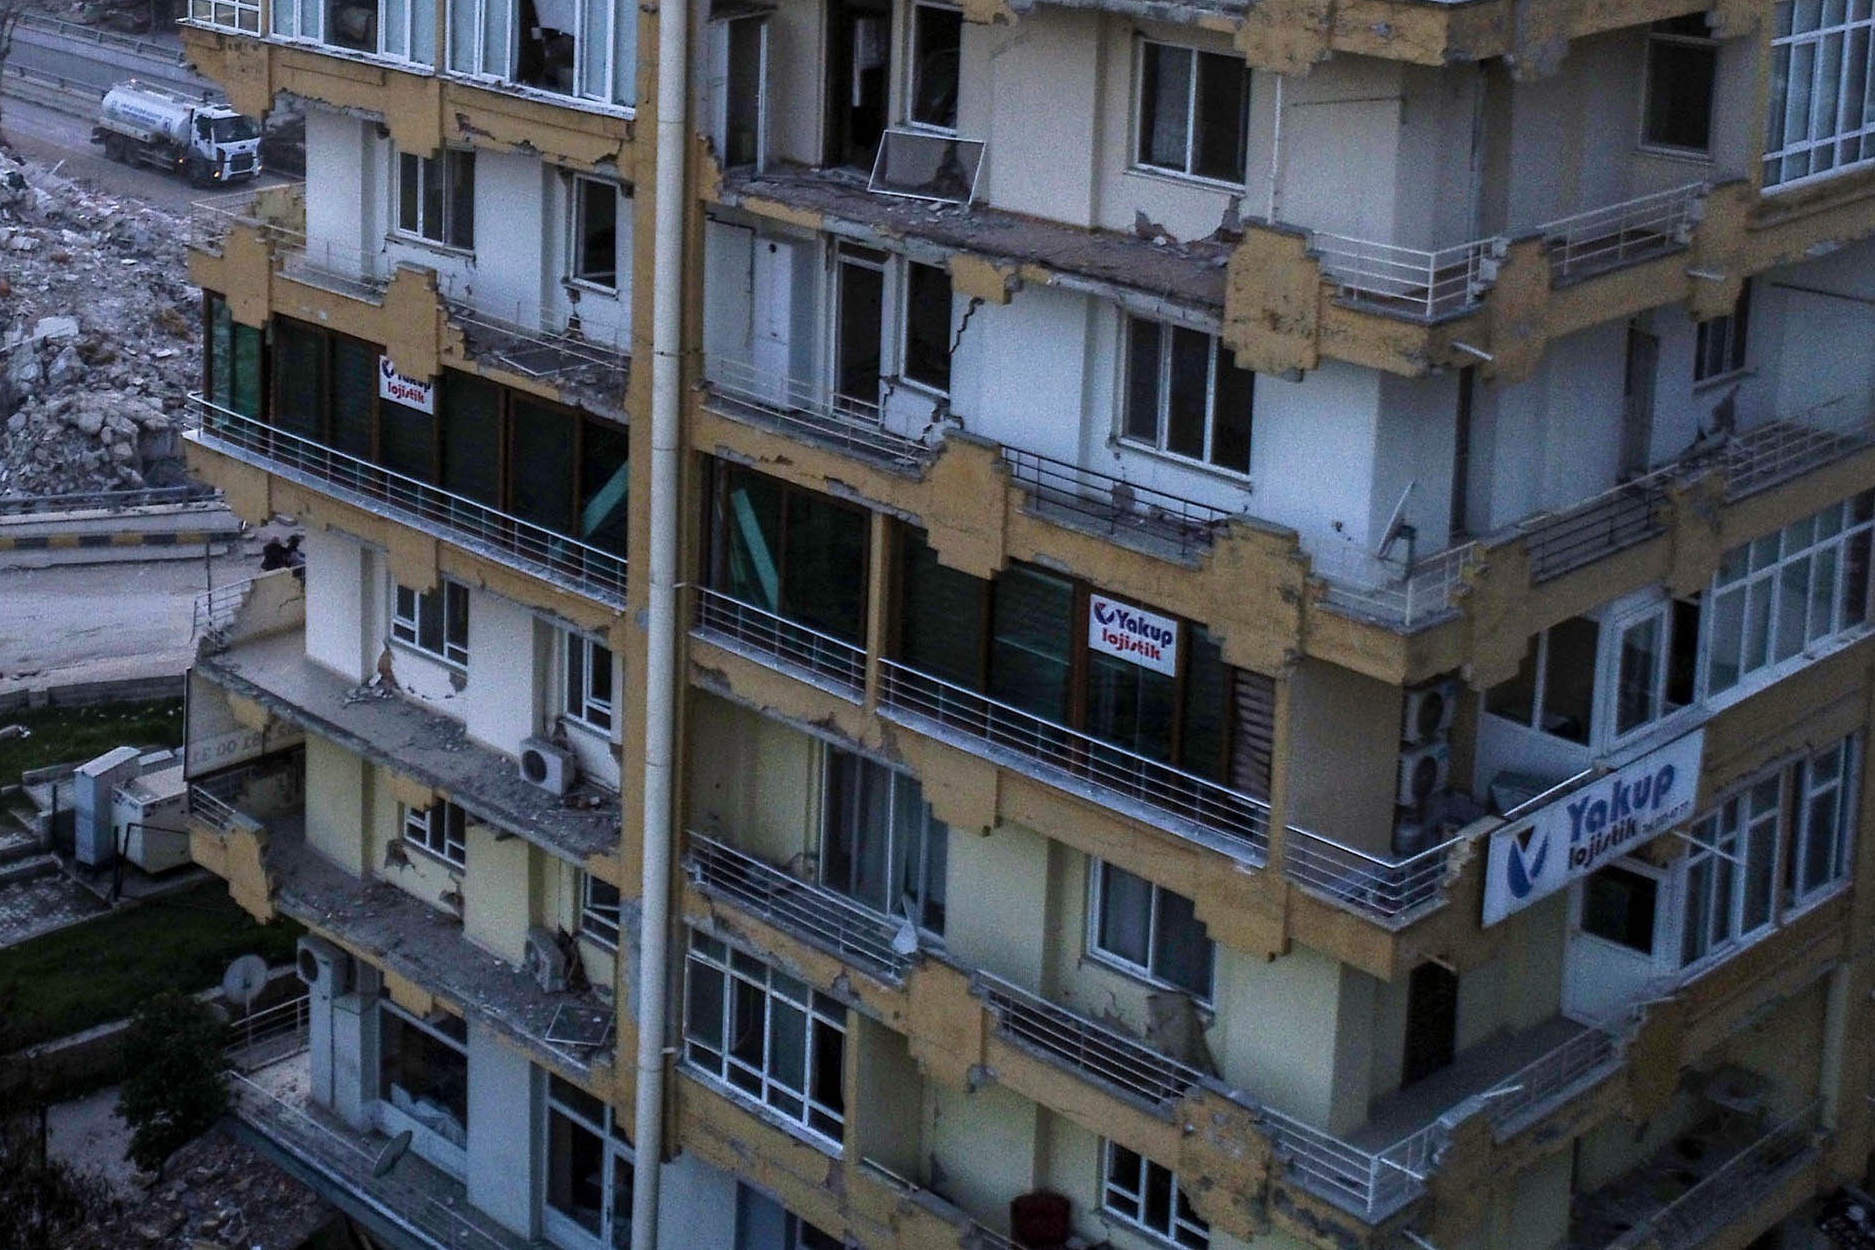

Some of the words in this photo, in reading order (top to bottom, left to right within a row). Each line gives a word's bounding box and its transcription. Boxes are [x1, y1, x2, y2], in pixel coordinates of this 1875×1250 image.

[387, 381, 425, 404] lojistik
[1102, 627, 1161, 661] lojistik
[1115, 608, 1173, 649] Yakup
[1566, 763, 1675, 843] Yakup
[1567, 816, 1637, 870] lojistik
